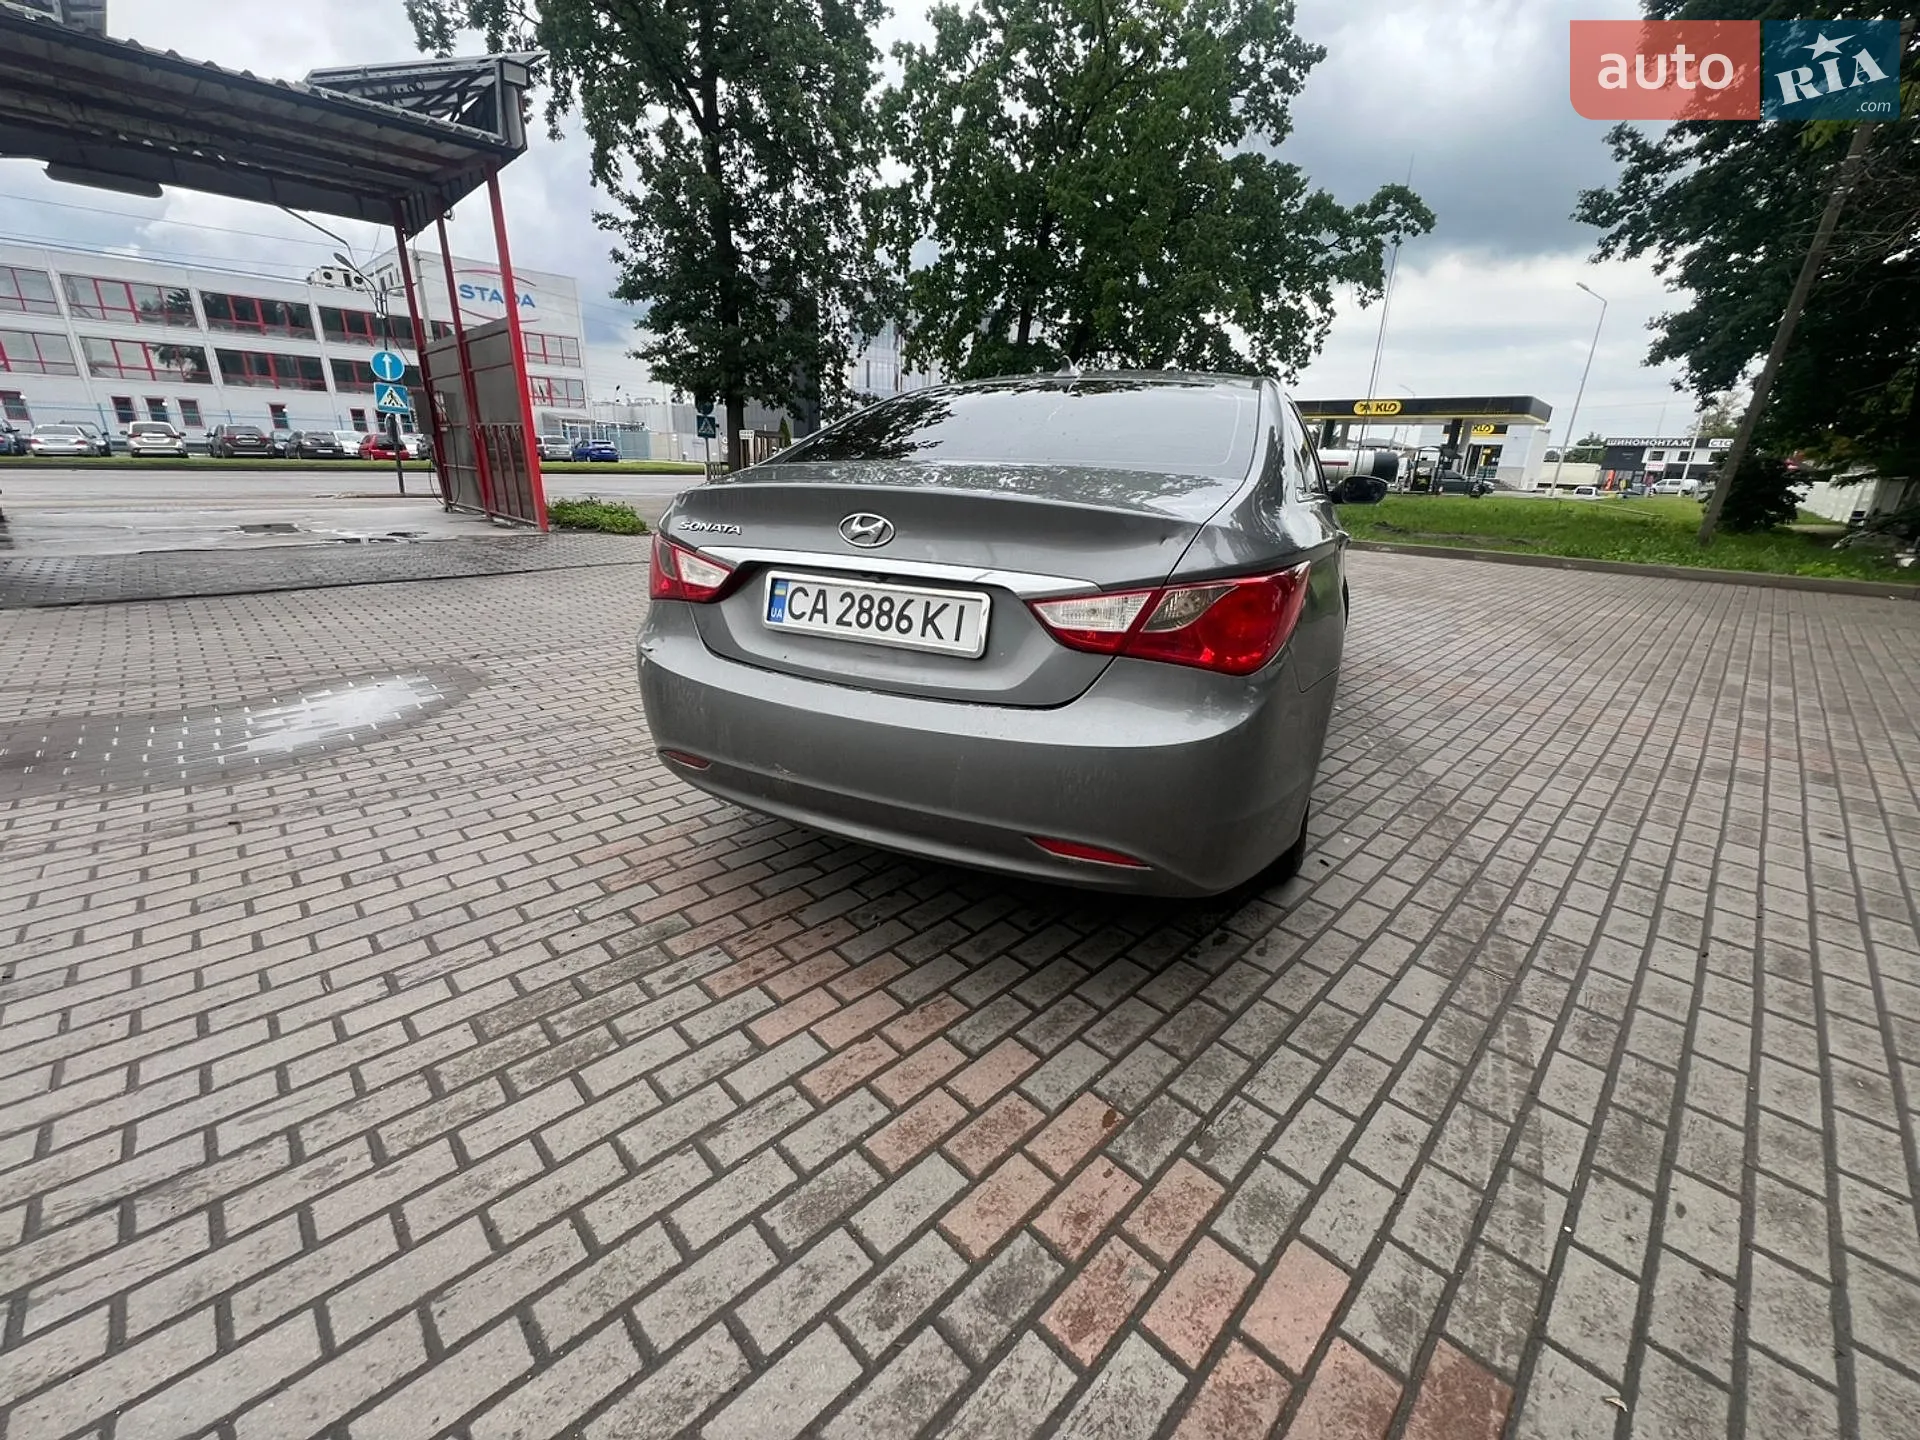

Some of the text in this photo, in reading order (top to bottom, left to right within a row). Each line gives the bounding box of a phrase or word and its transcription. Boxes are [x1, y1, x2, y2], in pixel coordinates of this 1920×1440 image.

[1606, 438, 1692, 447] ШИНОМОНТАЖ
[679, 521, 742, 535] SONATA
[770, 608, 783, 619] UA
[788, 586, 965, 642] CA 2886 KI
